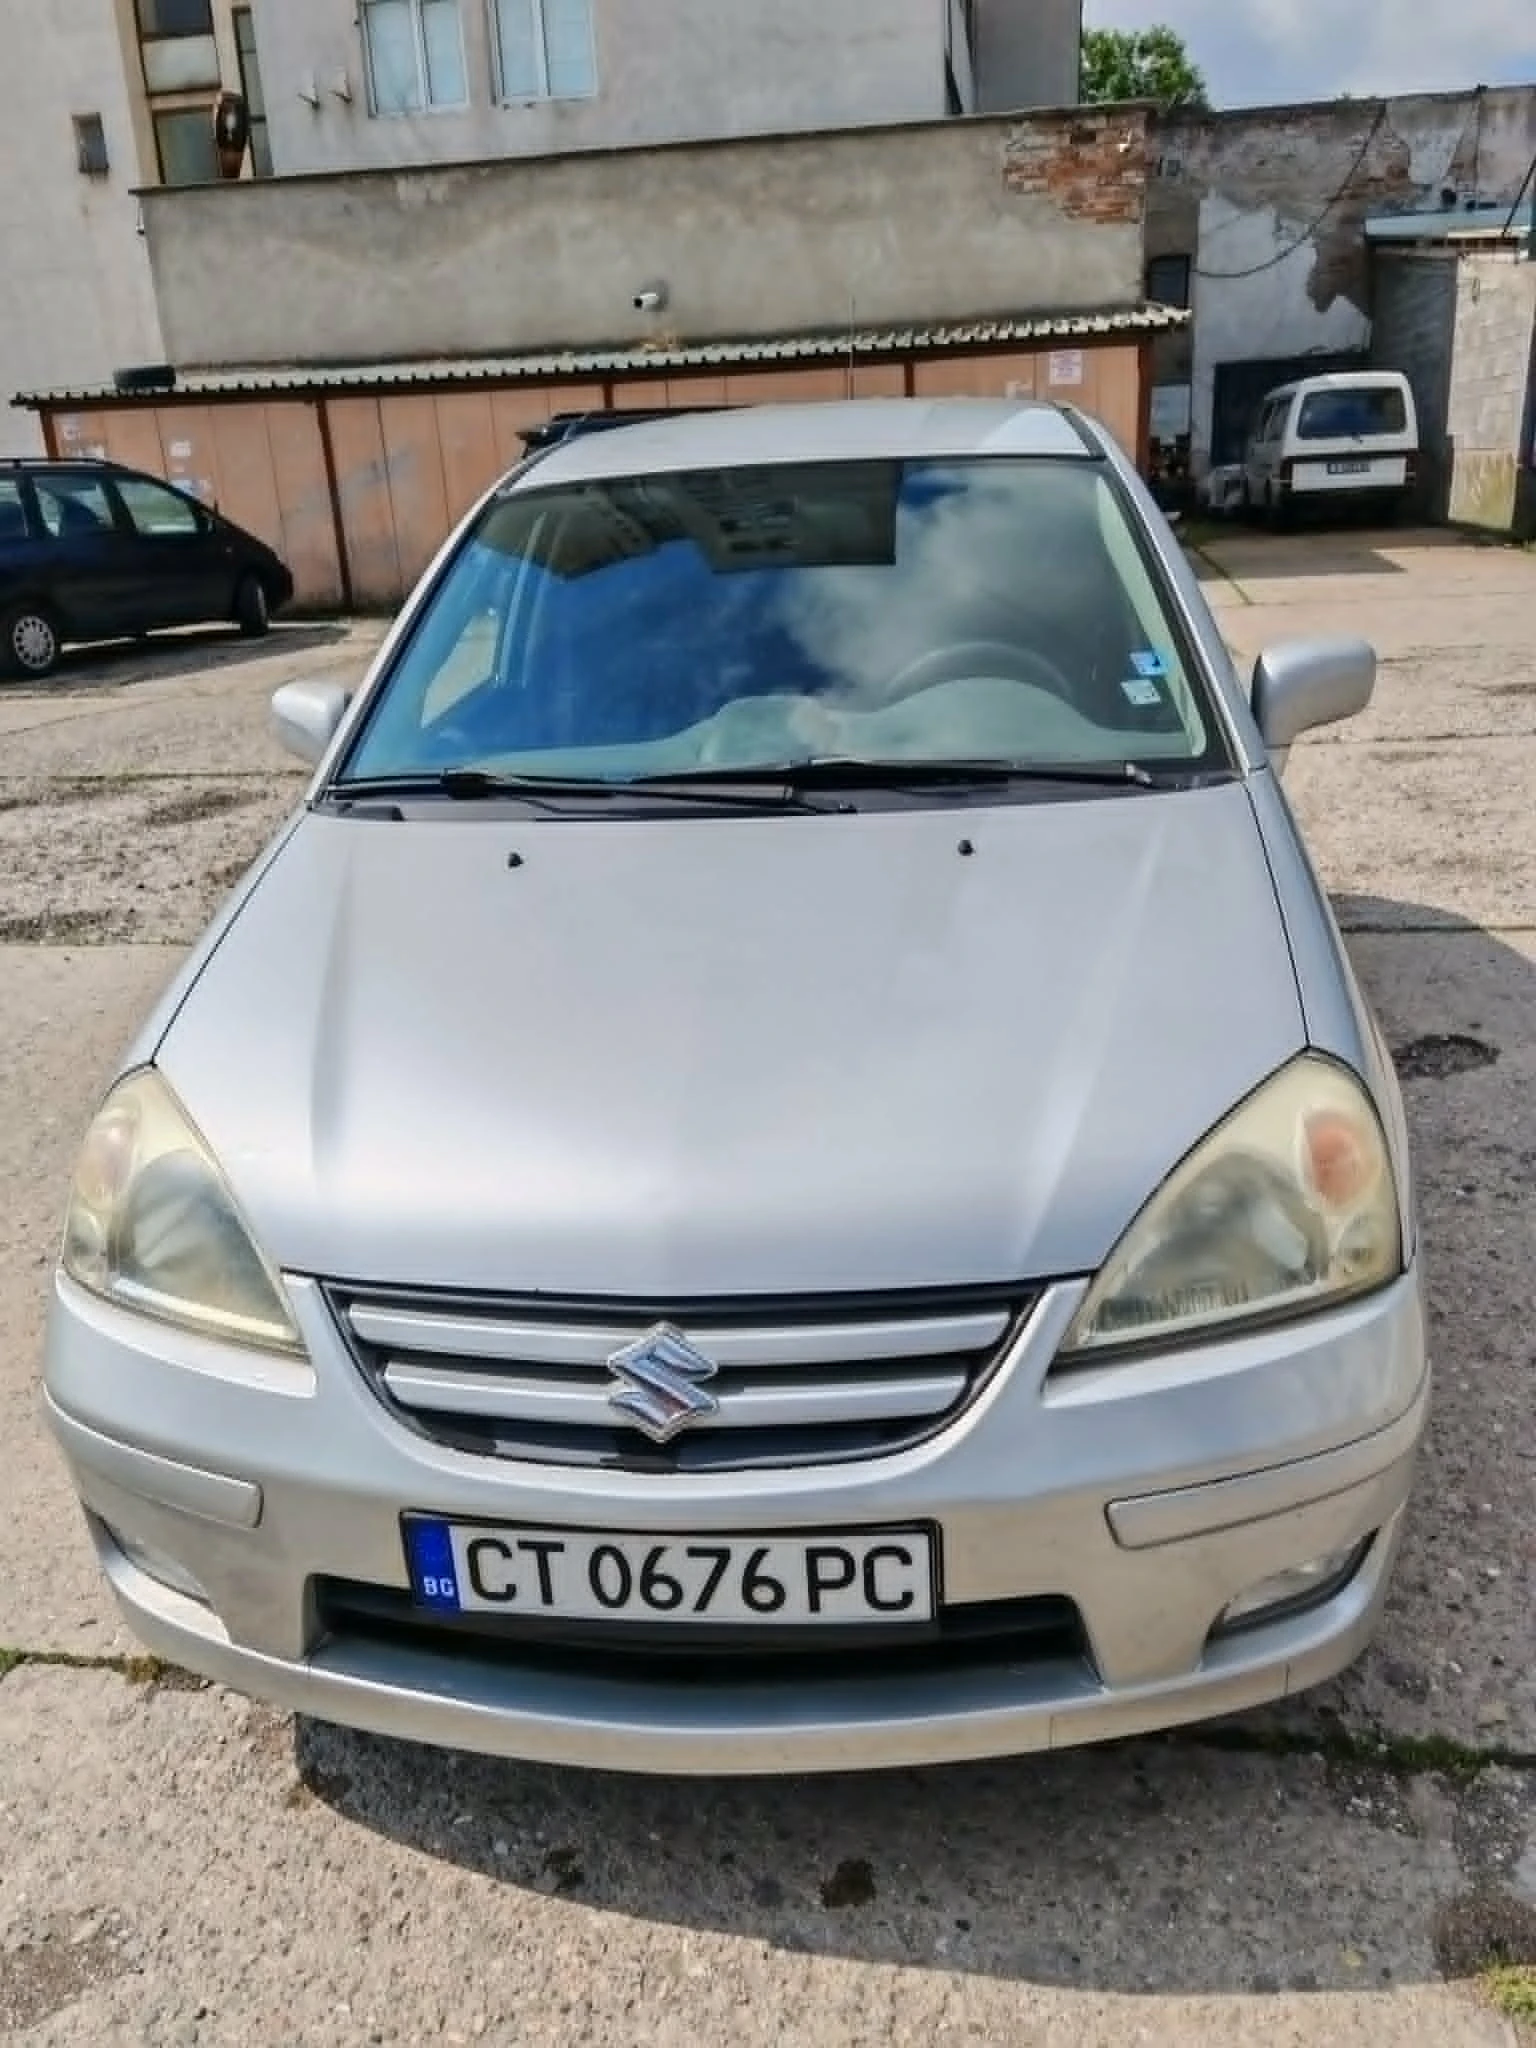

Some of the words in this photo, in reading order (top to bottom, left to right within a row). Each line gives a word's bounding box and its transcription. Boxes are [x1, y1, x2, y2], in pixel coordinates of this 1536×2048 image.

[424, 1575, 455, 1598] BG
[466, 1537, 565, 1604] CT
[588, 1544, 786, 1612] 0676
[804, 1545, 914, 1612] PC
